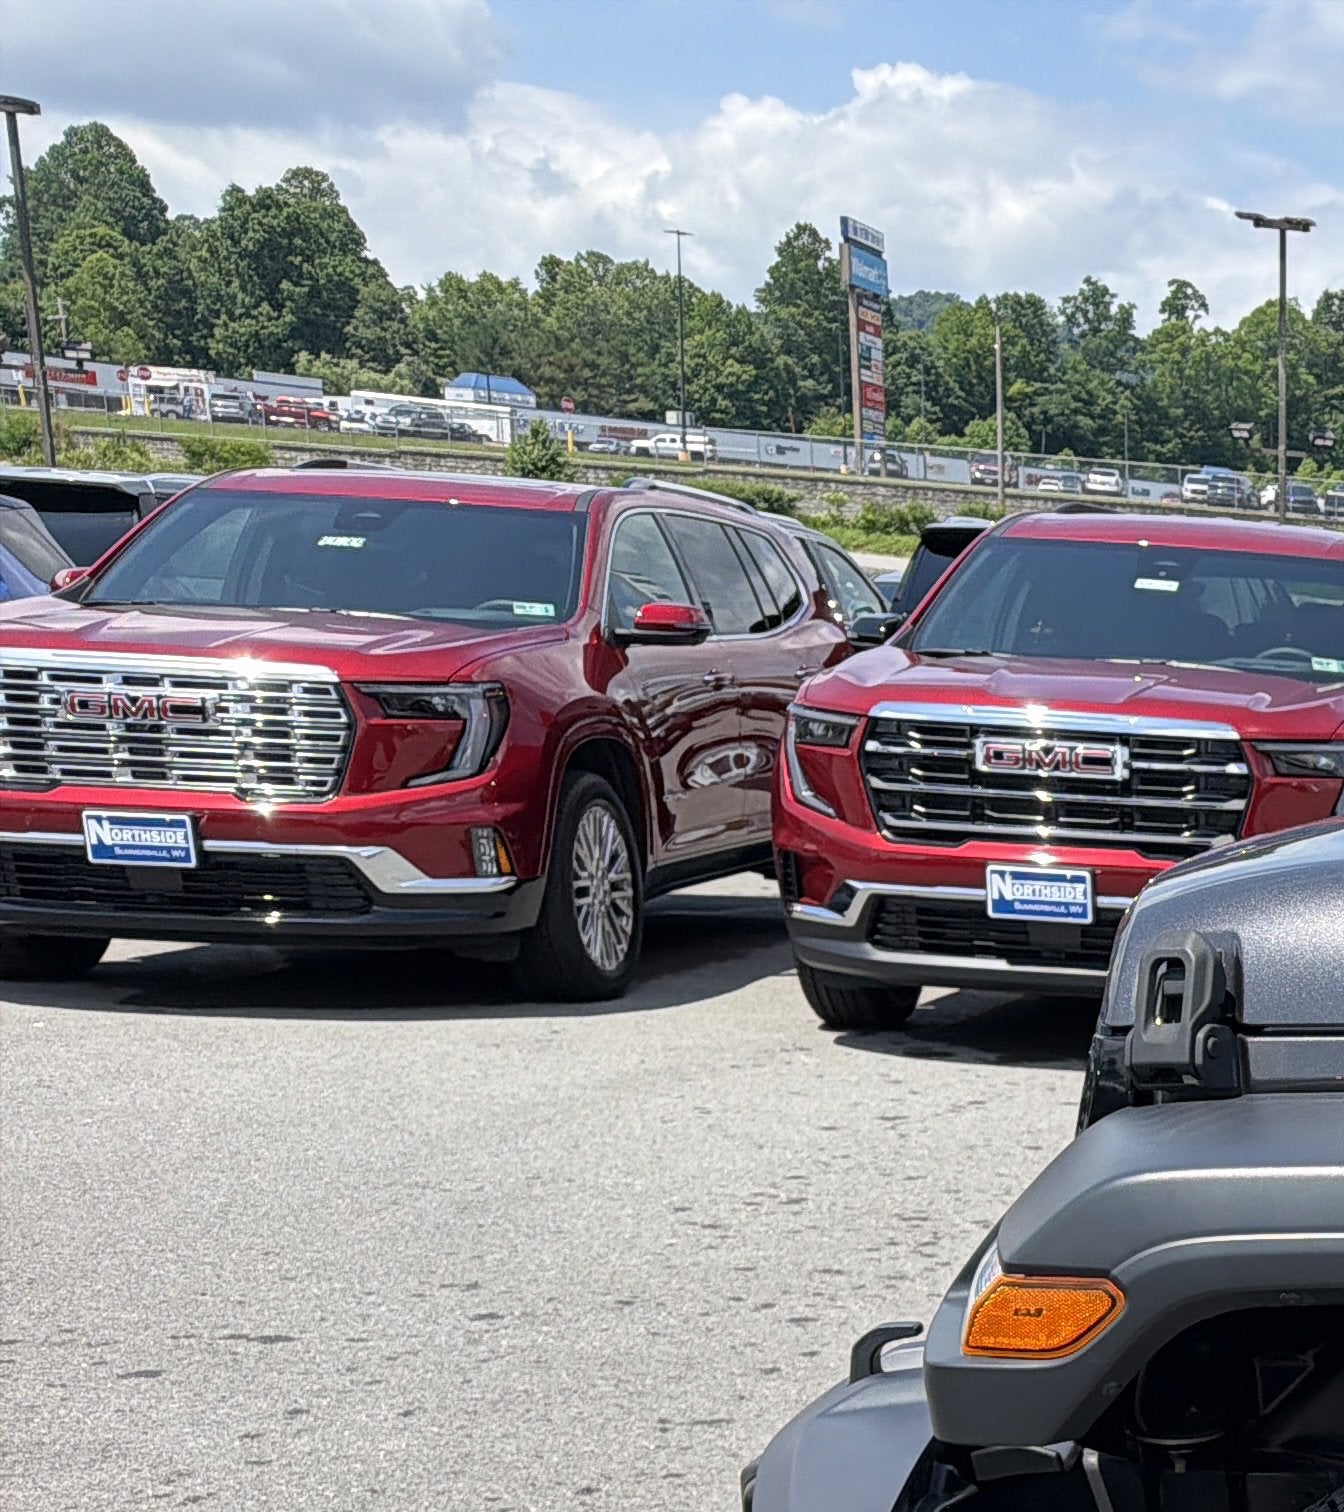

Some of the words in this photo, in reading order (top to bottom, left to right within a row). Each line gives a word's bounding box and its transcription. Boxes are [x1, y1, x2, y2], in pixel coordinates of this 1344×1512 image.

[68, 692, 203, 723] GMC
[984, 744, 1113, 774] GMC
[87, 818, 187, 846] NORTHSIDE
[991, 872, 1086, 901] NORTHSIDE
